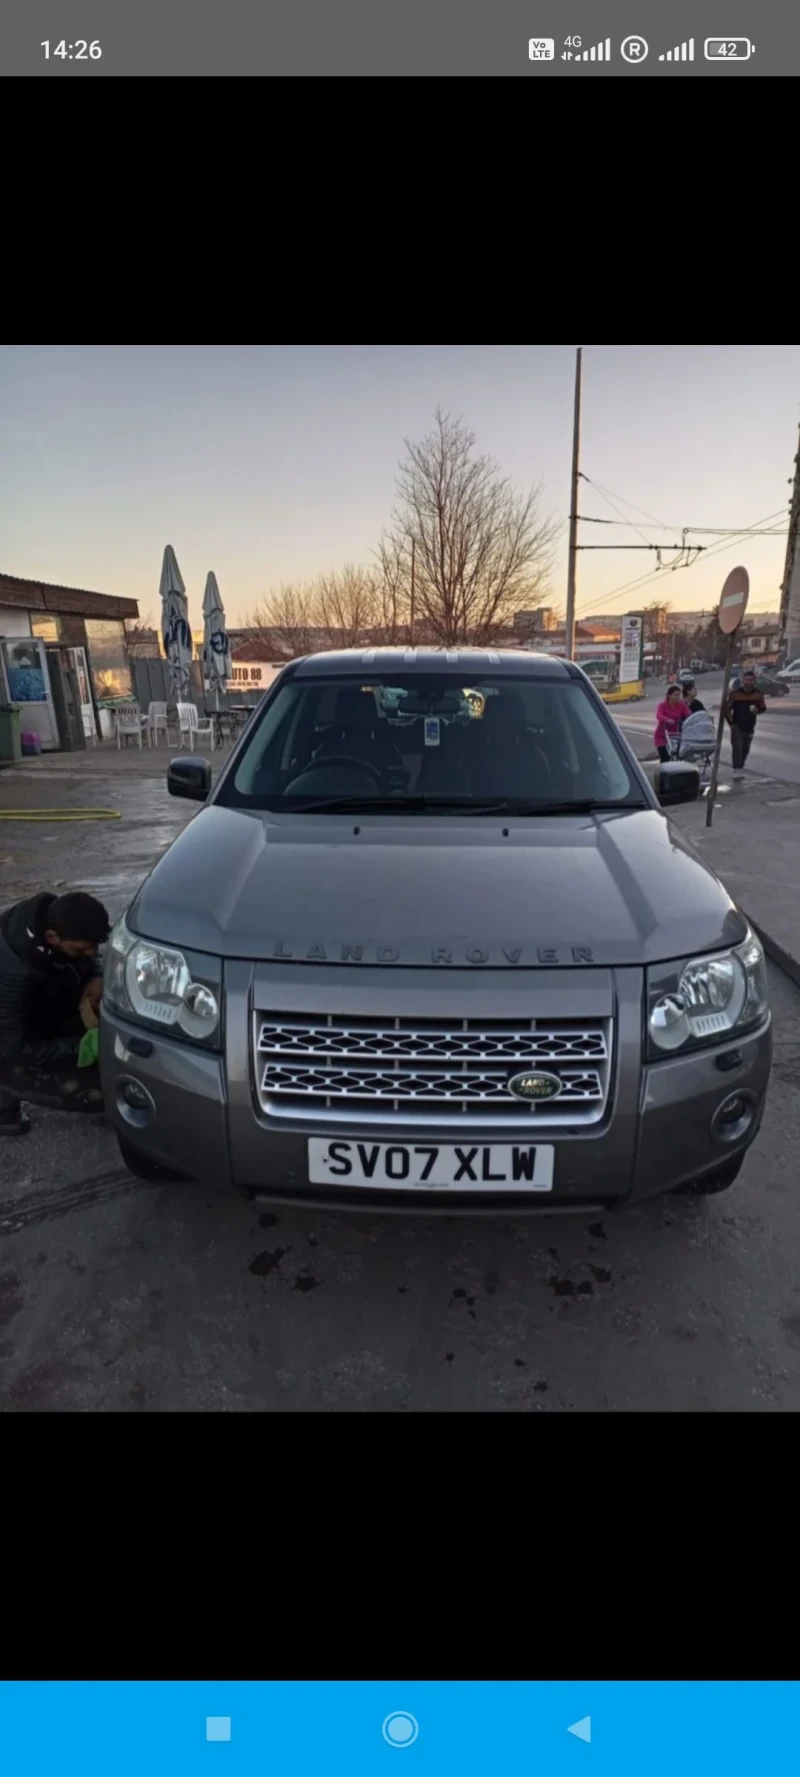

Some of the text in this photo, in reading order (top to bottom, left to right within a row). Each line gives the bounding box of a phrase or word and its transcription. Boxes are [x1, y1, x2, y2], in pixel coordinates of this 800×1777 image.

[231, 667, 262, 680] UTO 88
[273, 941, 595, 964] LAND ROVER
[327, 1142, 537, 1181] SV07 XLW
